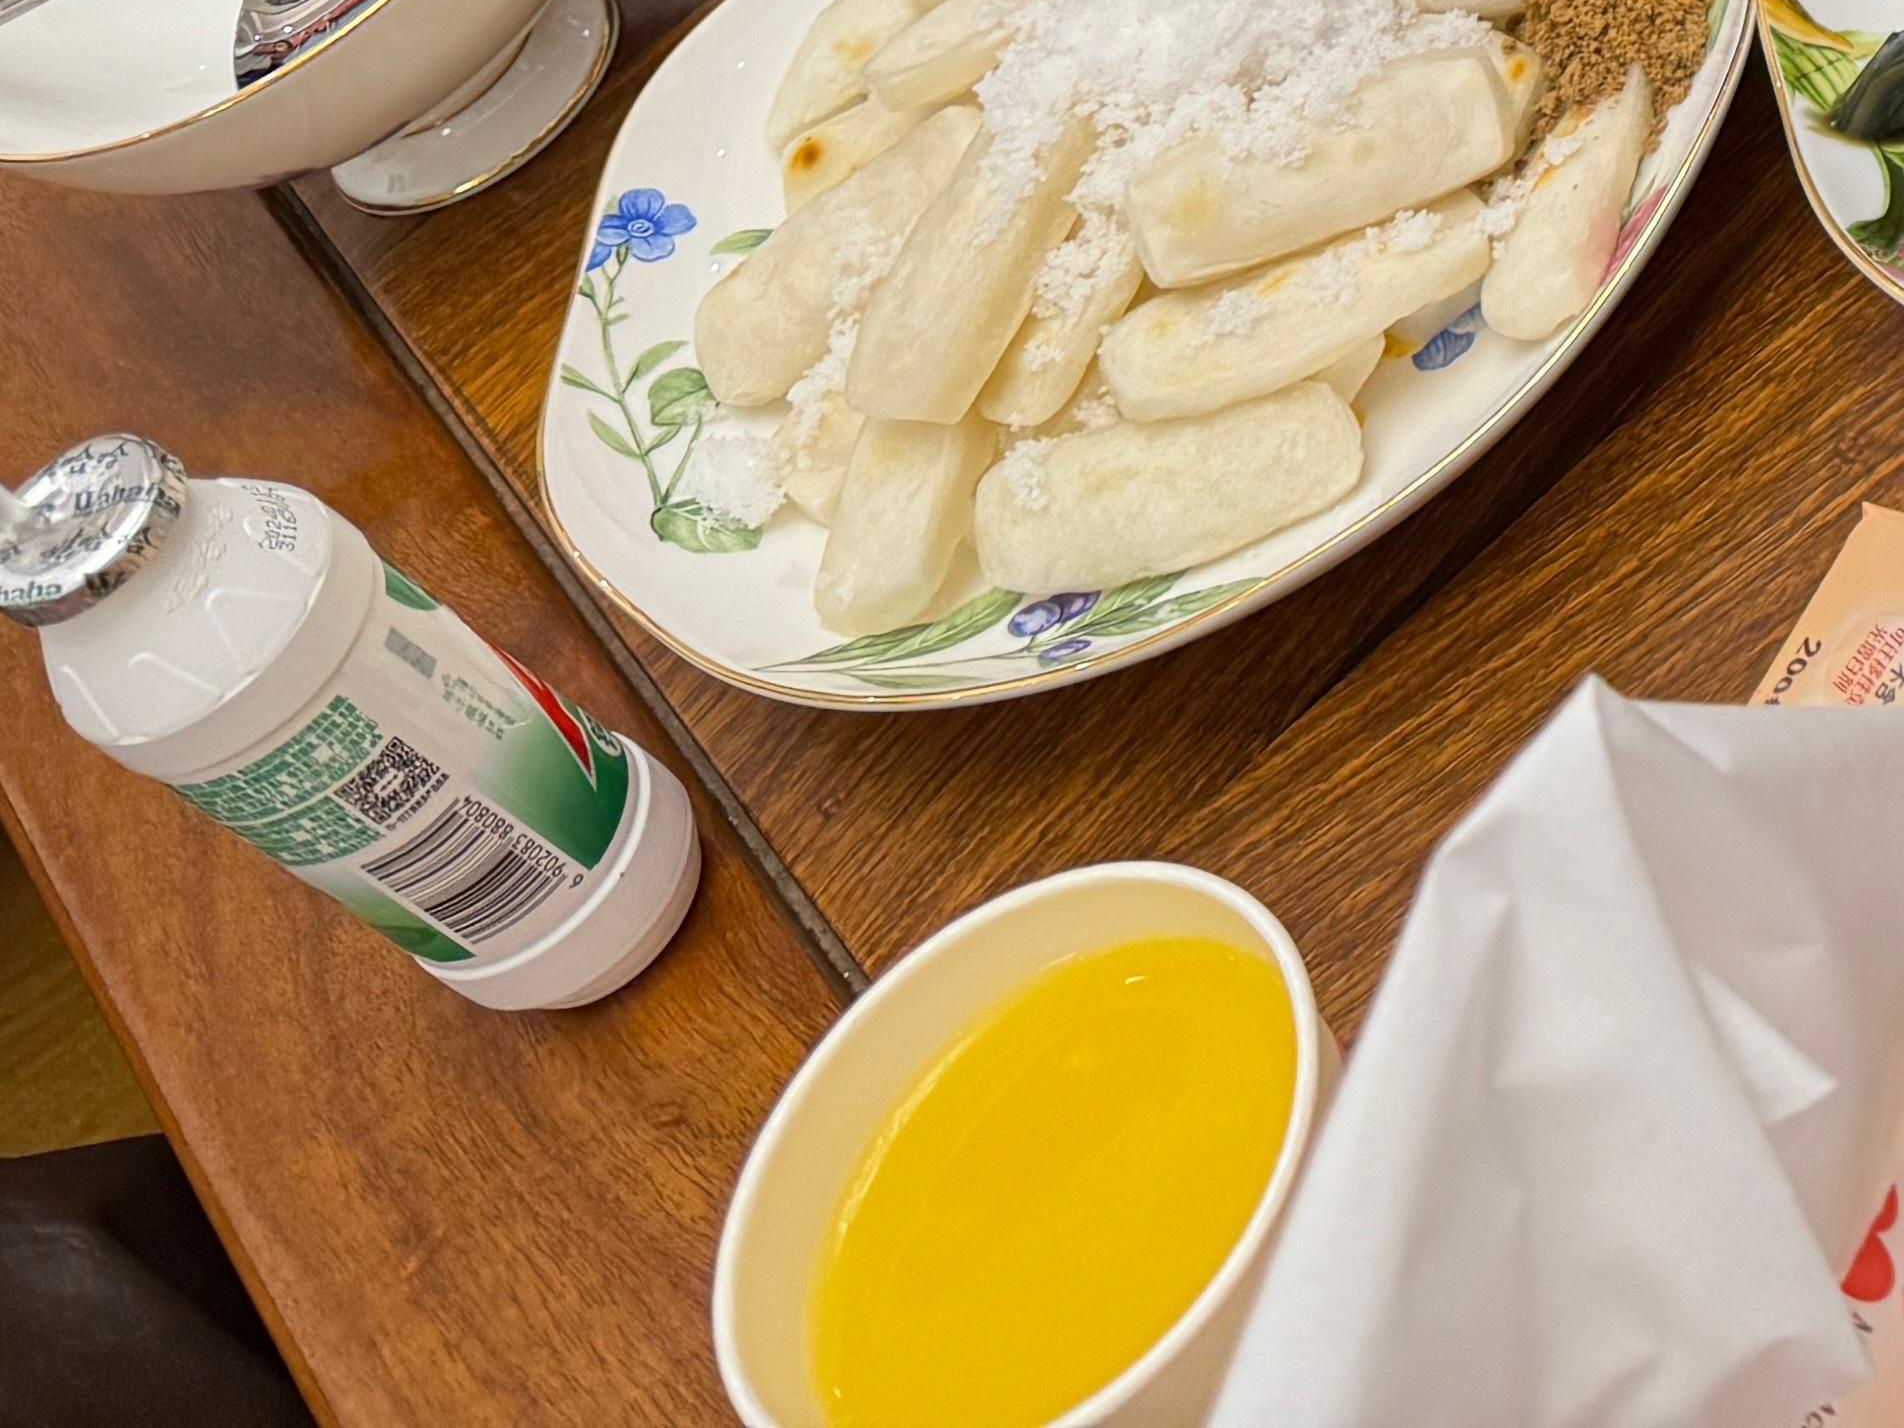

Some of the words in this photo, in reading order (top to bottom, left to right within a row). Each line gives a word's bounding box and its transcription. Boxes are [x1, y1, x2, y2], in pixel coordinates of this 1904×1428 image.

[459, 795, 515, 840] 880804
[511, 833, 567, 878] 902083
[568, 873, 584, 889] 6
